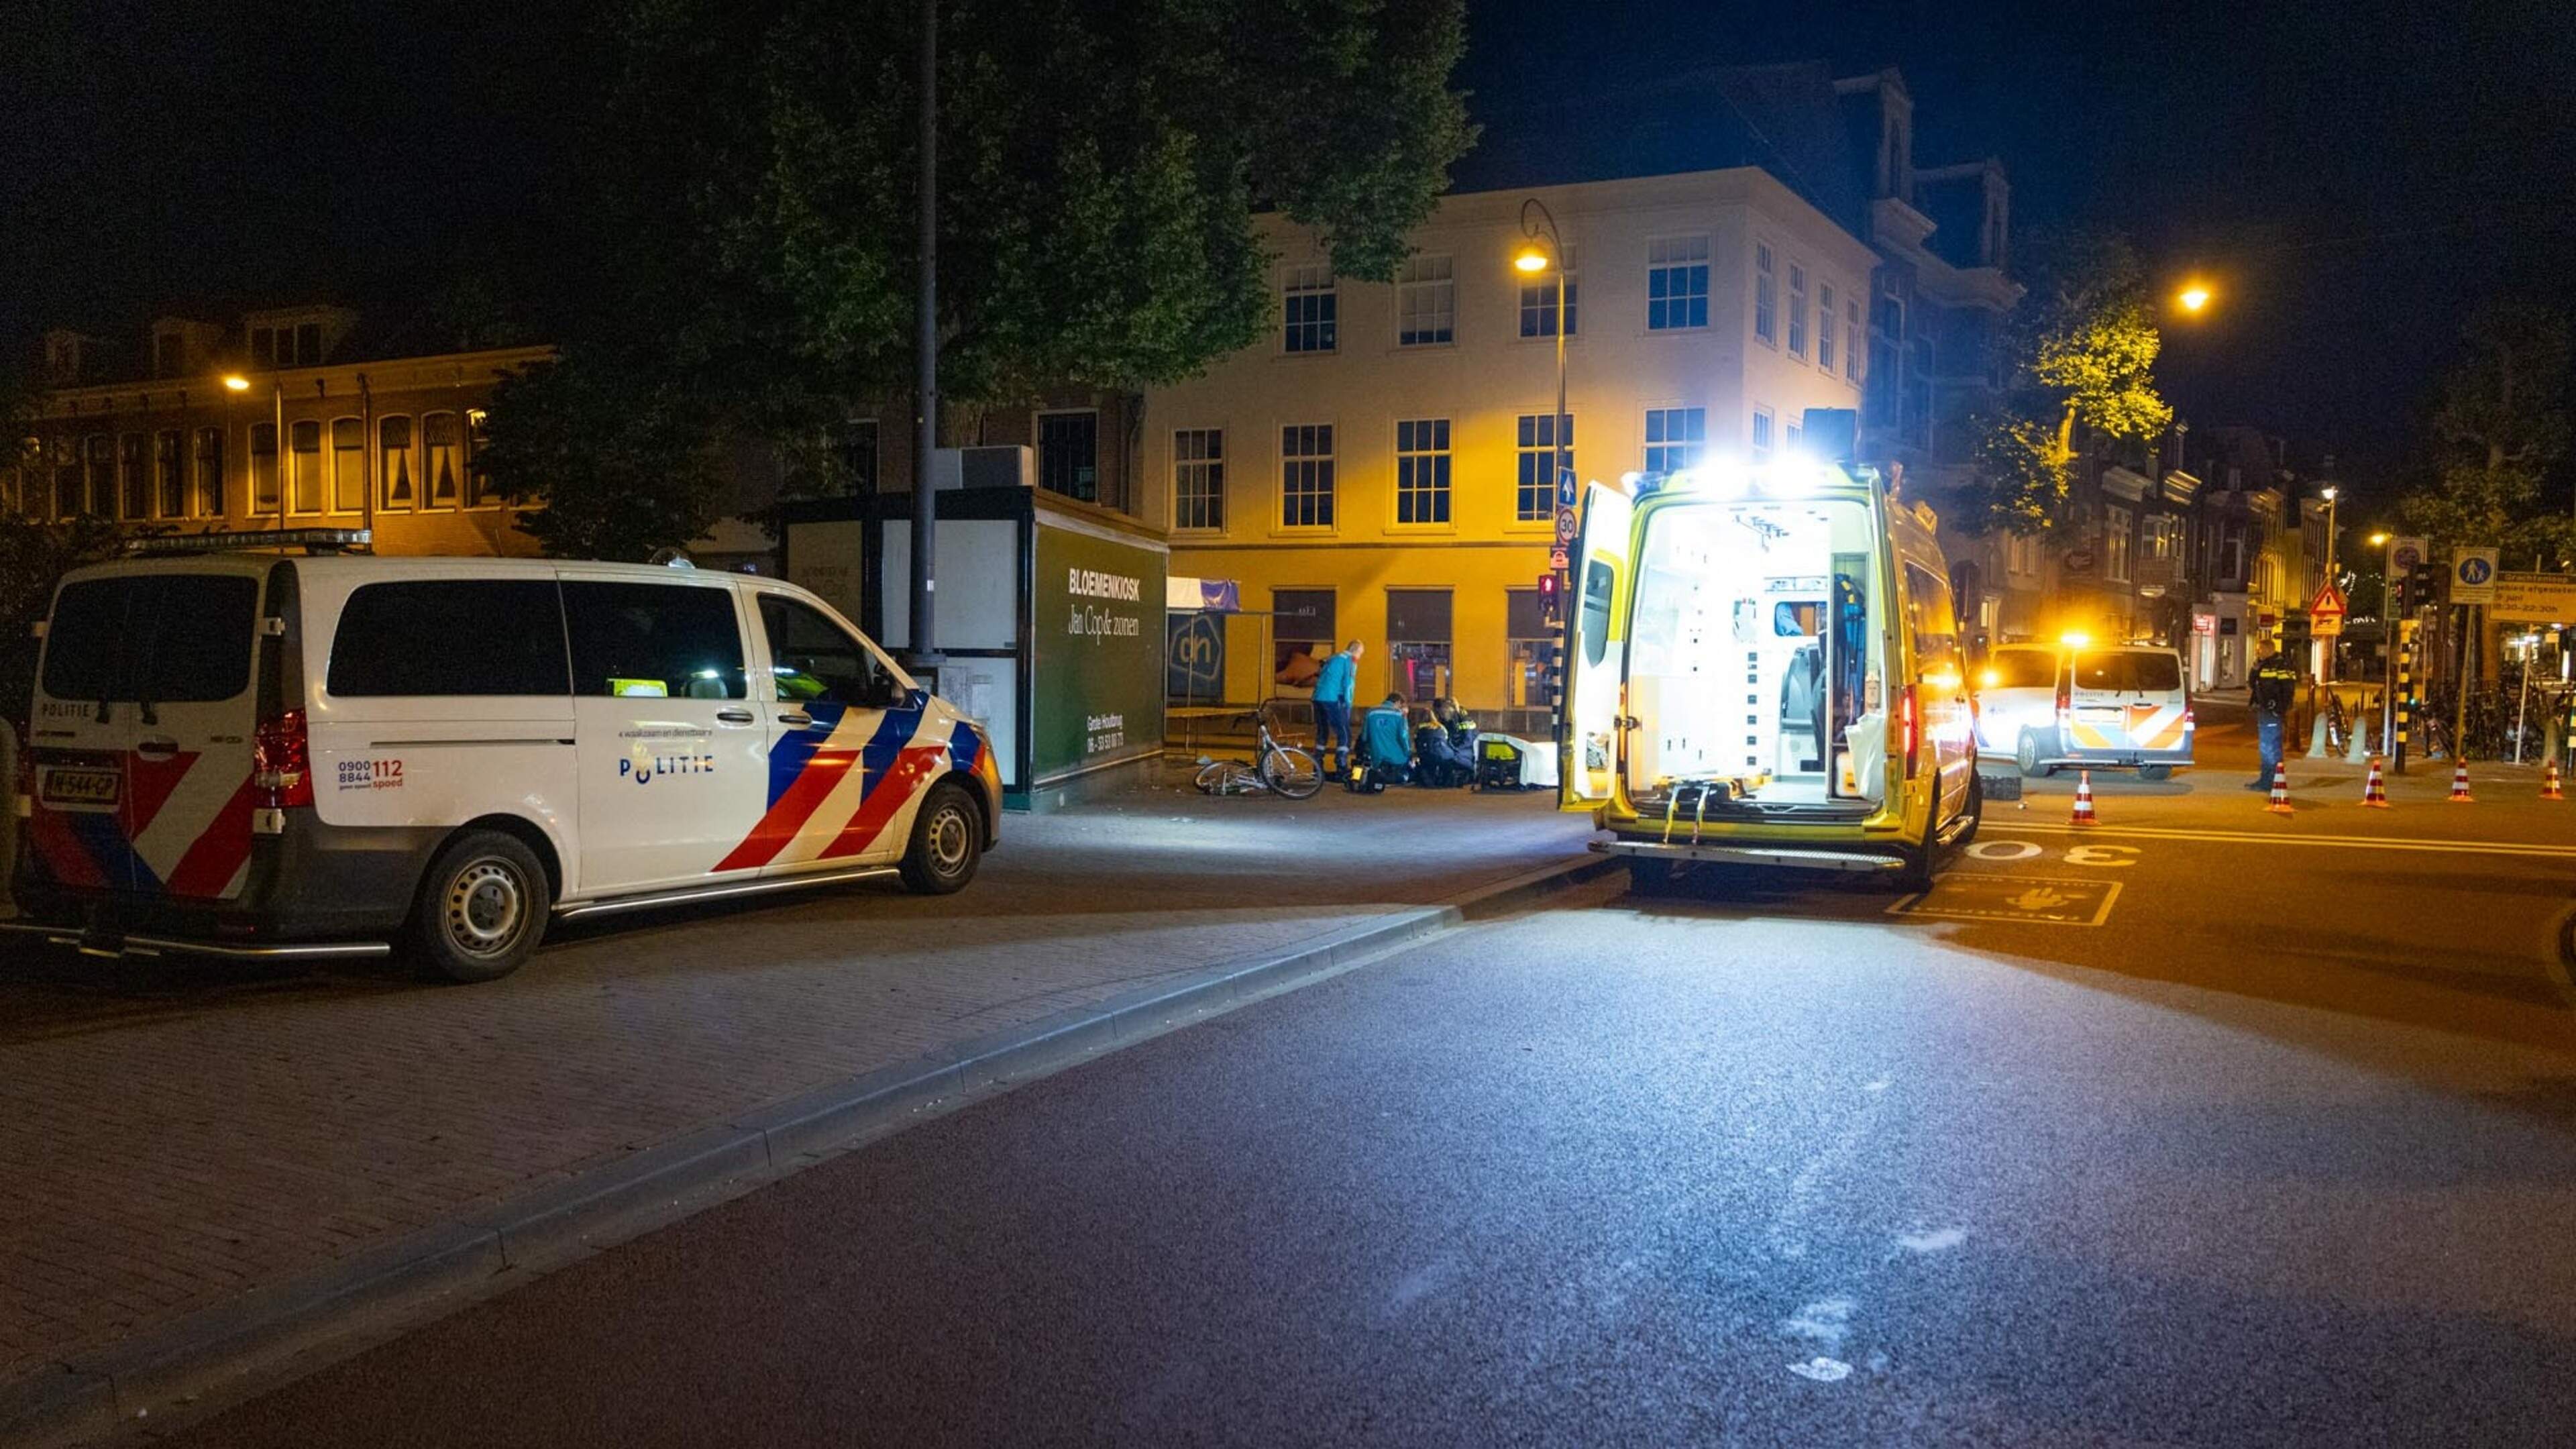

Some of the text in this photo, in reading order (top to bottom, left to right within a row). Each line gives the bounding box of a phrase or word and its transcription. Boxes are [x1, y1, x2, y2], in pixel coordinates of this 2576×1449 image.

[1561, 519, 1573, 532] 30
[1069, 568, 1140, 602] BLOEMENKIOSK
[1069, 604, 1083, 635] Jan
[1113, 616, 1139, 636] zonen
[43, 704, 89, 717] POLITIE
[339, 761, 370, 771] 0900
[373, 760, 402, 777] 112
[620, 755, 713, 784] POLITIE
[339, 773, 370, 782] 8844
[373, 778, 402, 790] spoed
[1966, 840, 2142, 866] 30
